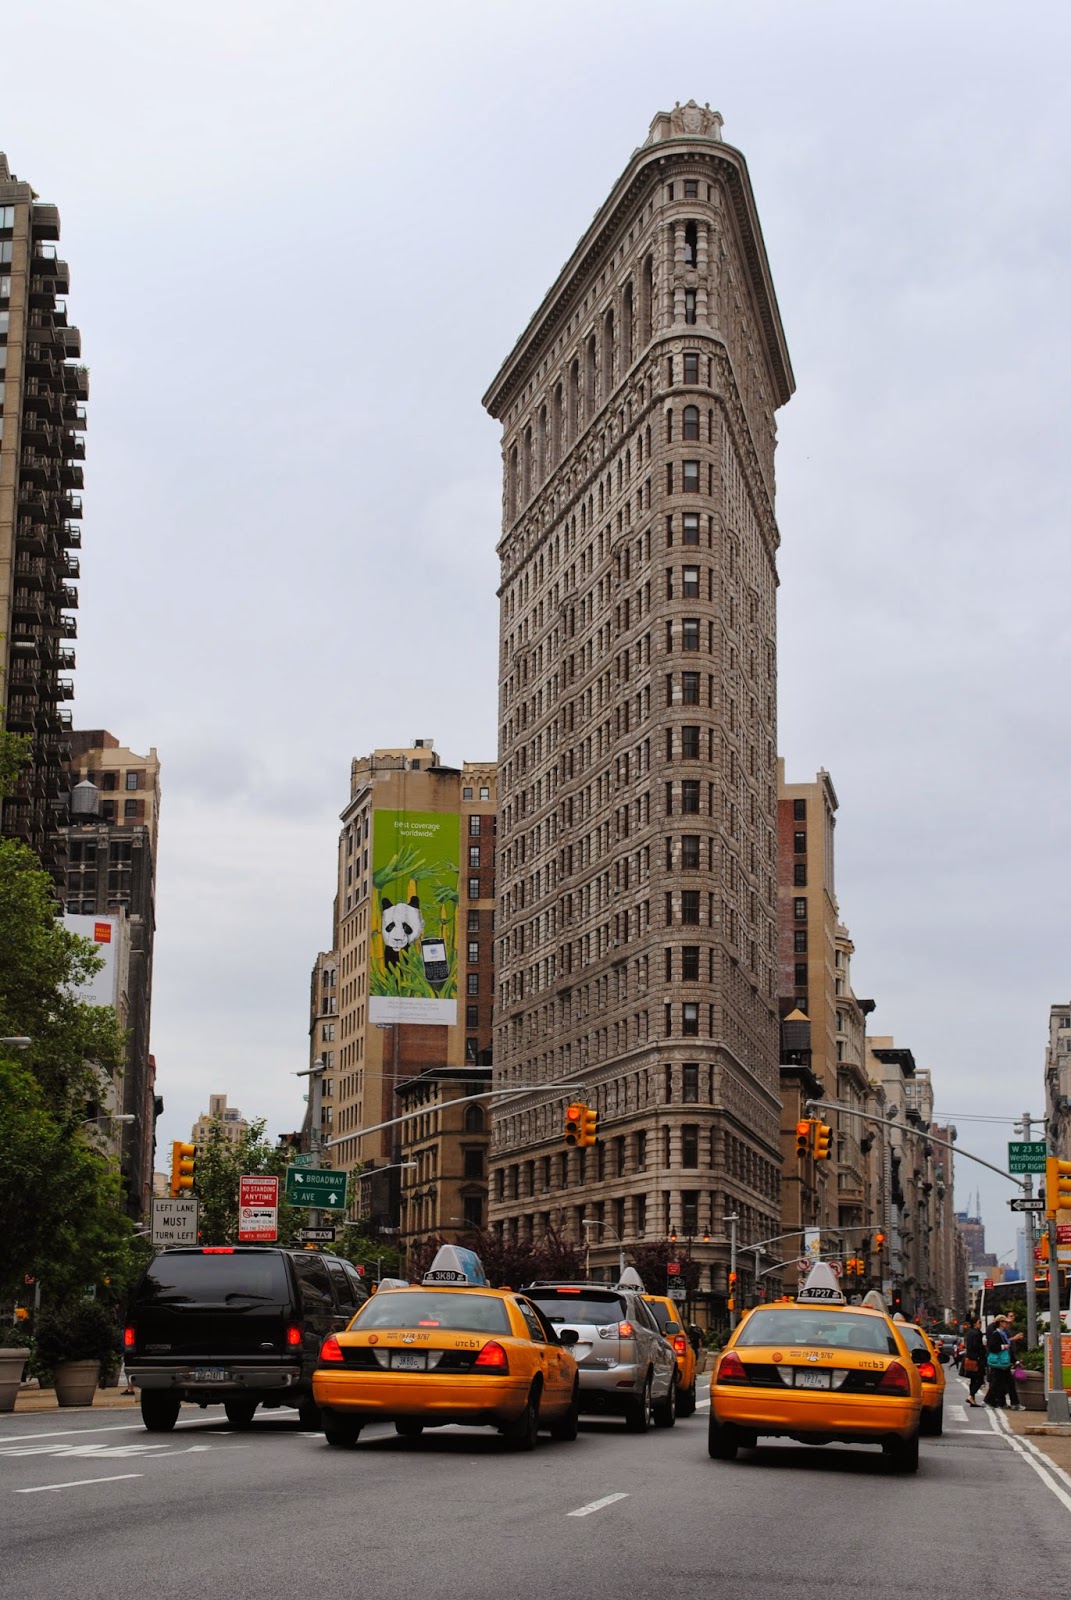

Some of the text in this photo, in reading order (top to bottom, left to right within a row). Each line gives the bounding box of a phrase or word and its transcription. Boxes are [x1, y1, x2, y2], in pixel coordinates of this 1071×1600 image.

[411, 823, 440, 831] coverage
[1010, 1154, 1046, 1162] Westbound
[1010, 1163, 1046, 1171] KEEP RIGHT
[306, 1174, 344, 1185] BROADWAY
[242, 1185, 276, 1193] NO STANDING
[244, 1193, 273, 1201] ANYTIME
[293, 1192, 316, 1201] 5 AVE
[156, 1204, 195, 1213] LEFT LANE
[163, 1217, 187, 1227] MUST
[155, 1231, 194, 1240] TURN LEFT
[435, 1271, 456, 1281] 3K80
[810, 1288, 831, 1298] 7P27
